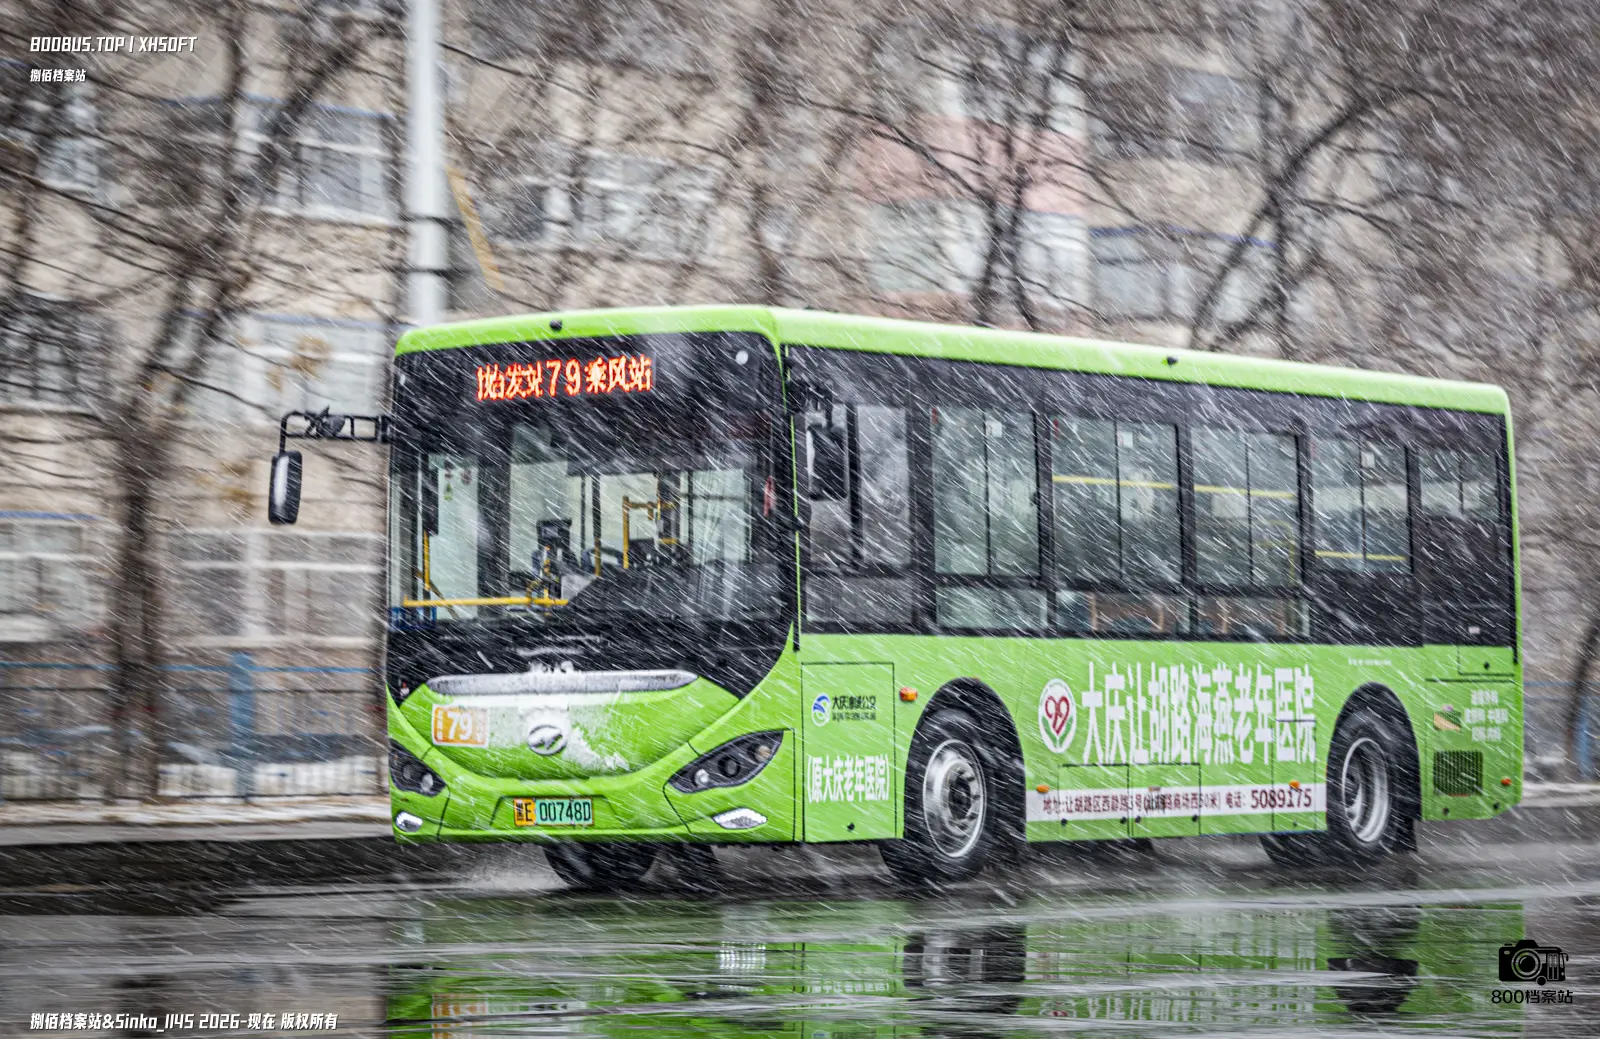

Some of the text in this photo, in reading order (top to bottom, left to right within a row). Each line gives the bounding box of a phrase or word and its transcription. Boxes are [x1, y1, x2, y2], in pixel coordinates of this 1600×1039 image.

[546, 358, 582, 396] 79
[585, 353, 652, 394] 乘风站
[447, 711, 473, 740] 79
[1081, 661, 1317, 765] 大庆让胡路海燕老年医院
[1250, 788, 1312, 809] 5089175
